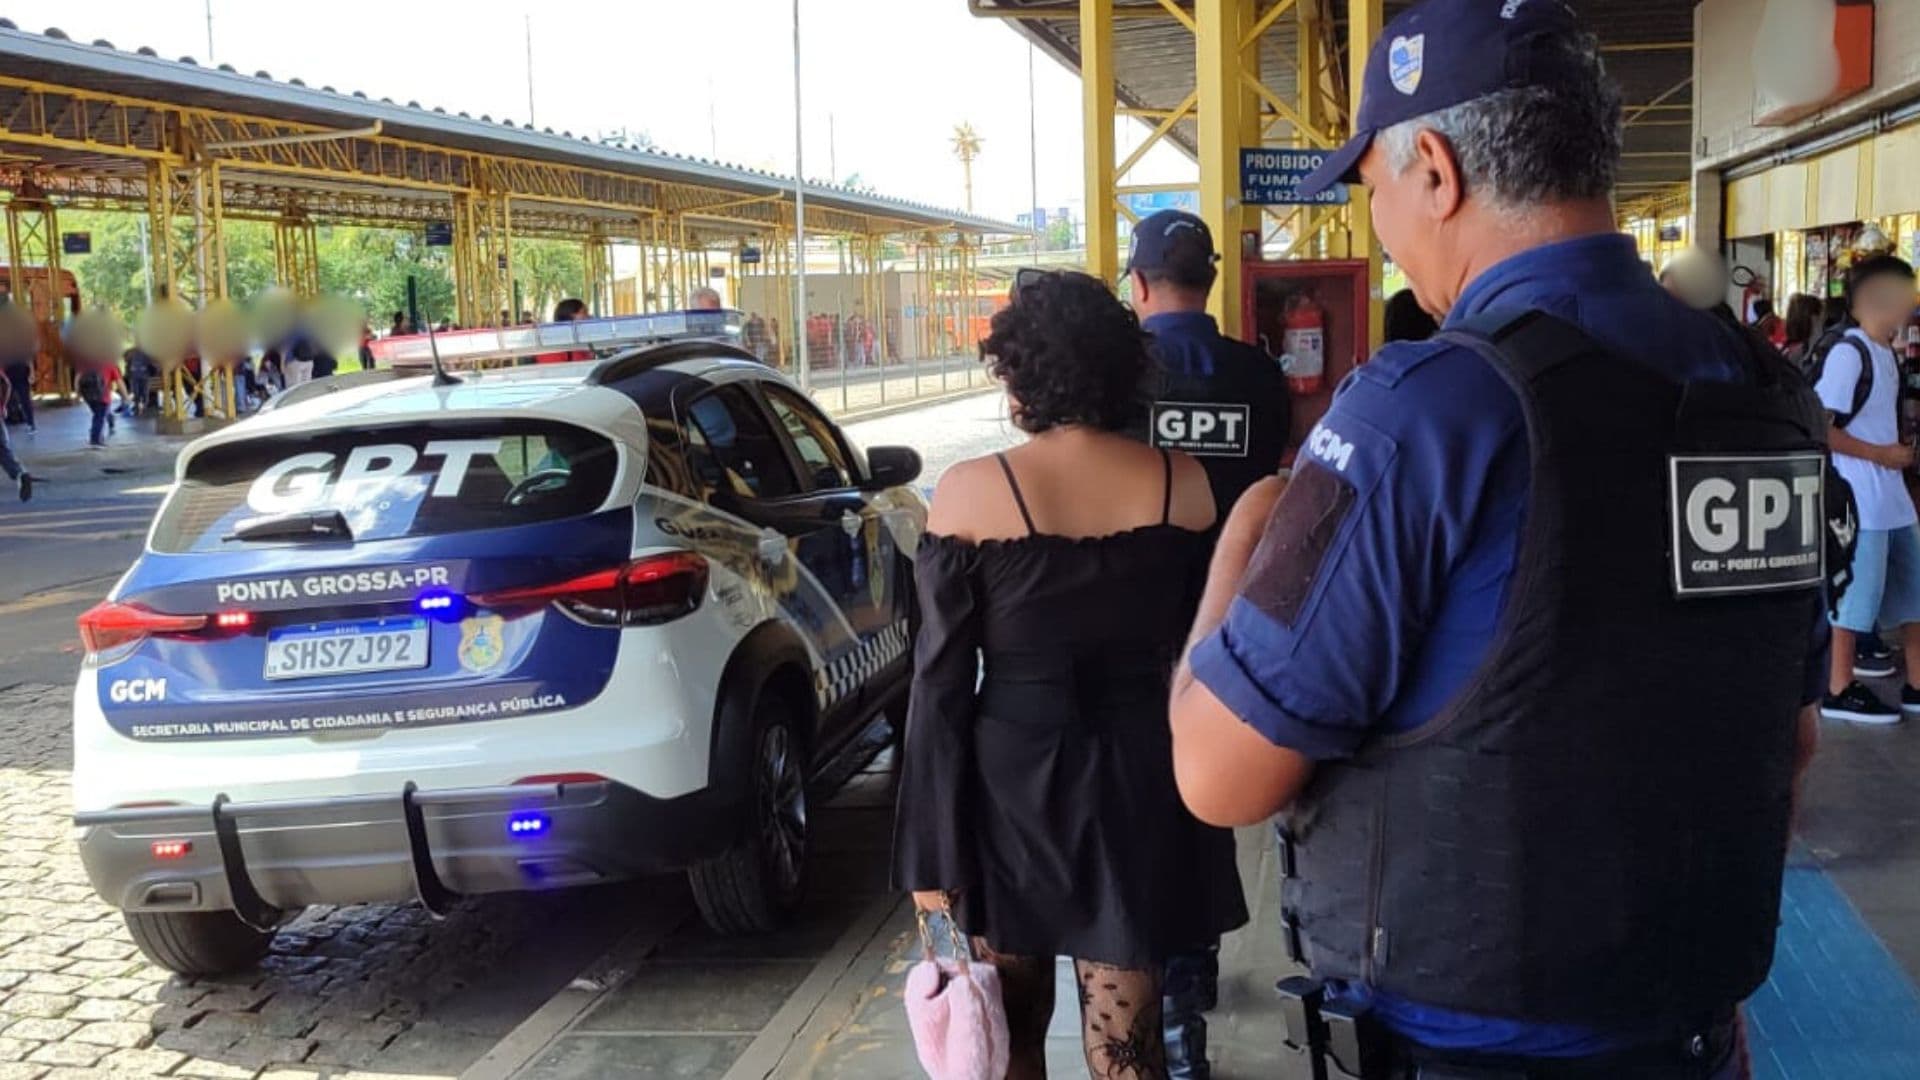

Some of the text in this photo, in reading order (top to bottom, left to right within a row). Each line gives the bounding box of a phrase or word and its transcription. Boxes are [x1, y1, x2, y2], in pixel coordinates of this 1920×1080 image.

[1245, 153, 1323, 170] PROIBIDO
[1248, 174, 1302, 186] FUMA
[1158, 409, 1243, 441] GPT
[247, 439, 501, 513] GPT
[1686, 475, 1820, 553] GPT
[217, 566, 449, 603] PONTA GROSSA-PR
[281, 633, 412, 672] SHS7J92
[110, 678, 167, 703] GCM
[132, 694, 566, 737] SECRETARIA MUNICIPAL DE CIDADANIA E SEGURANÇA PÚBLICA
